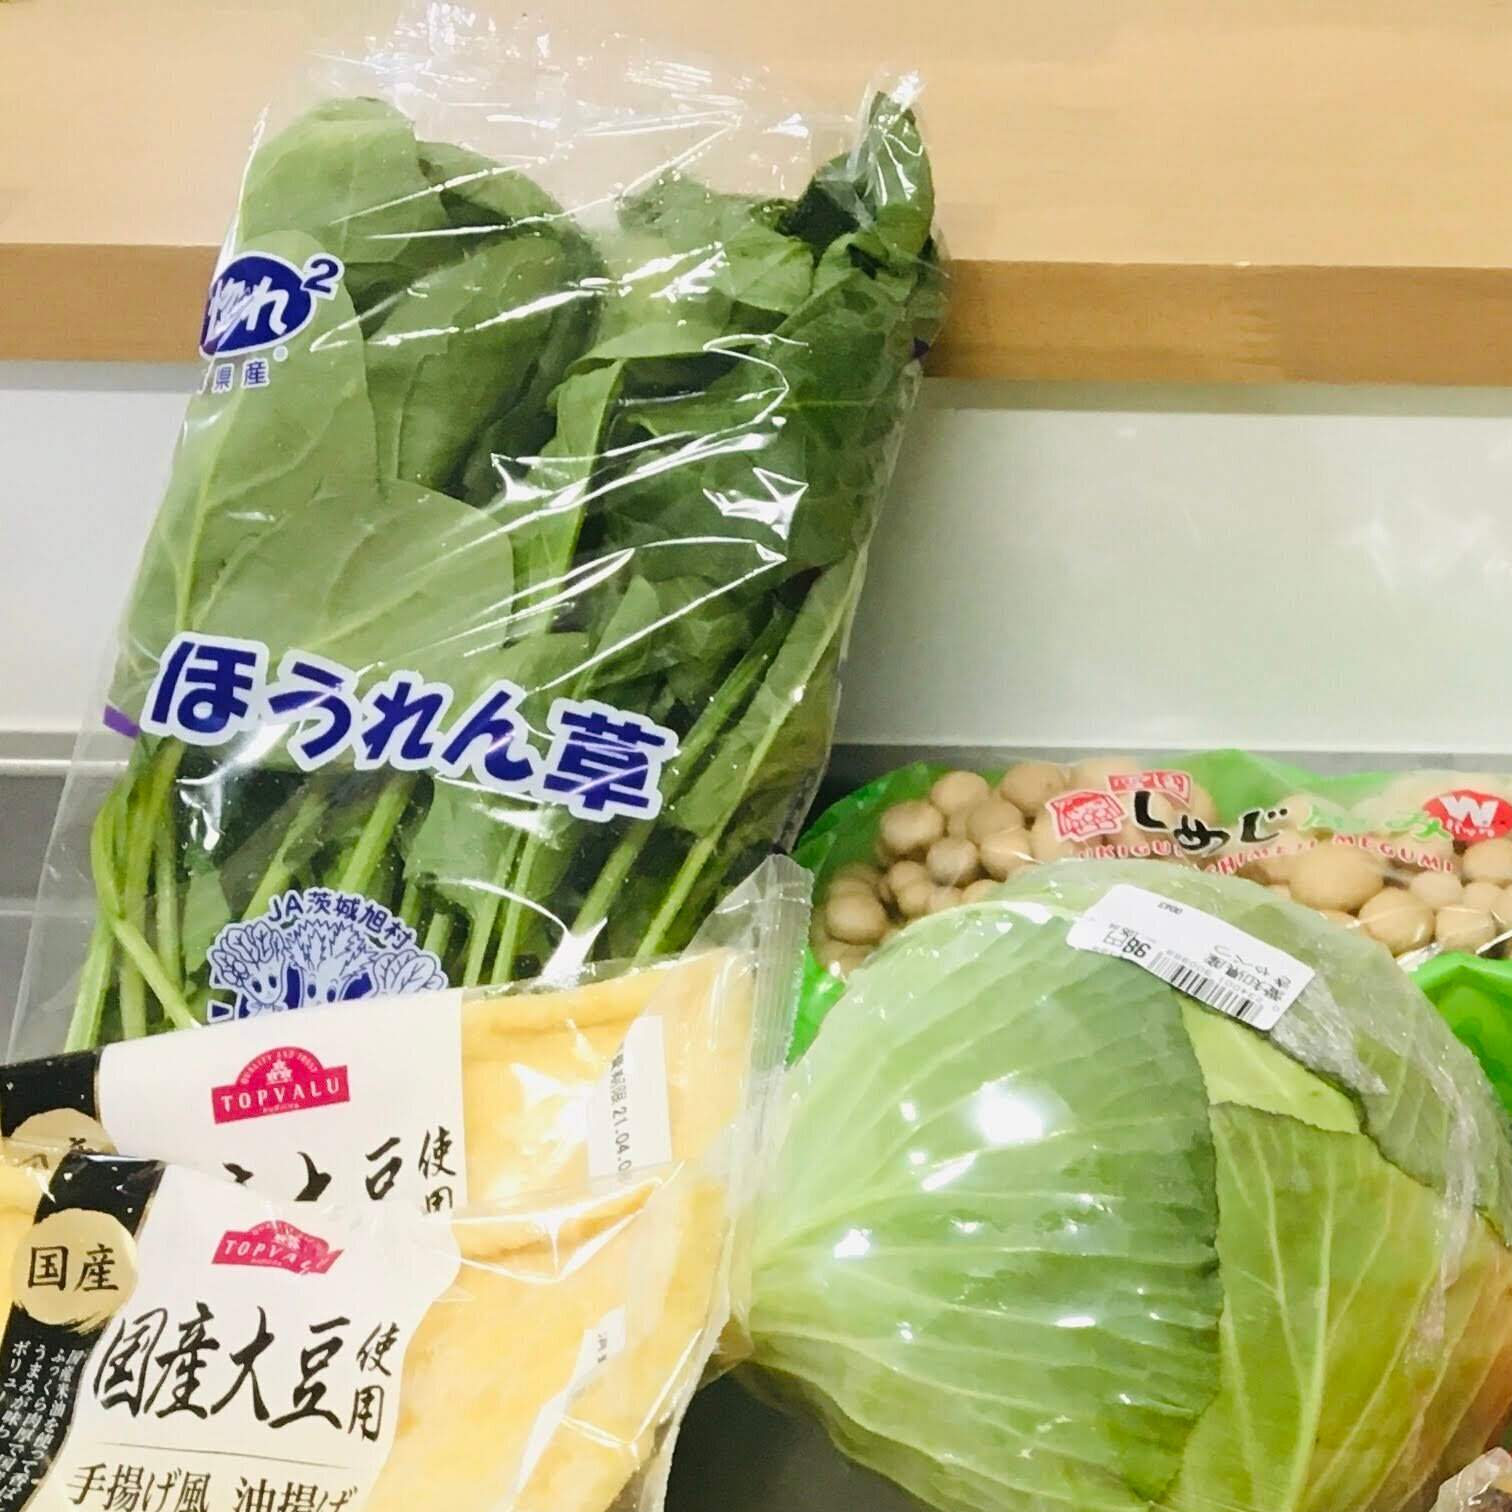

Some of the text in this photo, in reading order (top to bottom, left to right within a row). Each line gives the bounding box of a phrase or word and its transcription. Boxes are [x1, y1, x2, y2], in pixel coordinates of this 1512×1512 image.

[201, 361, 270, 391] 県産
[147, 638, 672, 814] ほうれん草
[1134, 790, 1289, 852] しめじ
[267, 890, 413, 949] JA茨城旭村
[220, 1077, 341, 1113] TOPVALU
[28, 1243, 120, 1293] 国産
[94, 1302, 401, 1443] 国産大豆 使用
